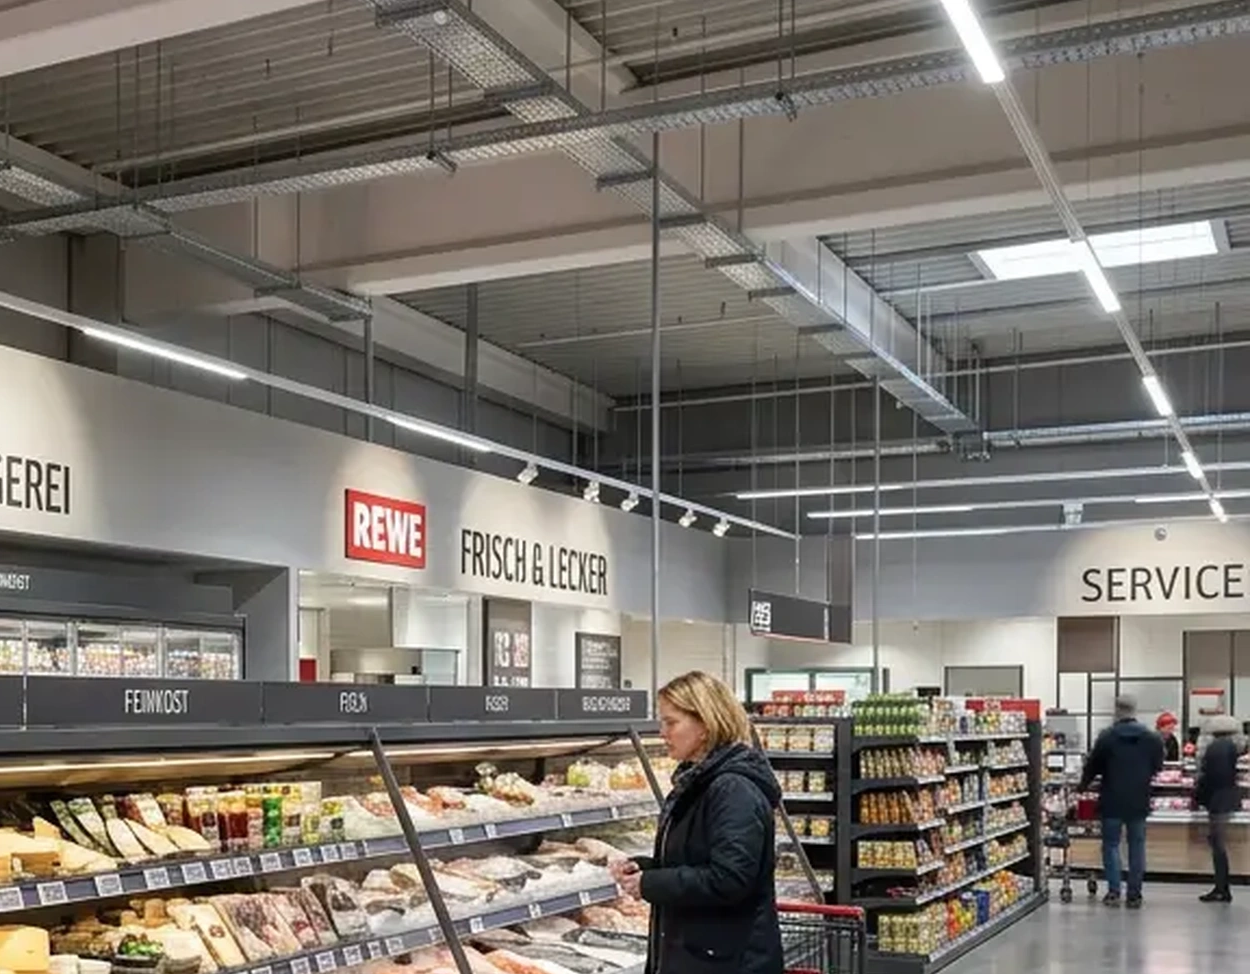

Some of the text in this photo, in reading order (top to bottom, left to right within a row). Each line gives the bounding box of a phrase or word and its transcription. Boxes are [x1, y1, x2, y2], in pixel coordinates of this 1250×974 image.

[353, 501, 422, 558] REWE
[461, 529, 526, 583] FRISCH
[550, 545, 608, 595] LECKER
[1081, 564, 1244, 602] SERVICE
